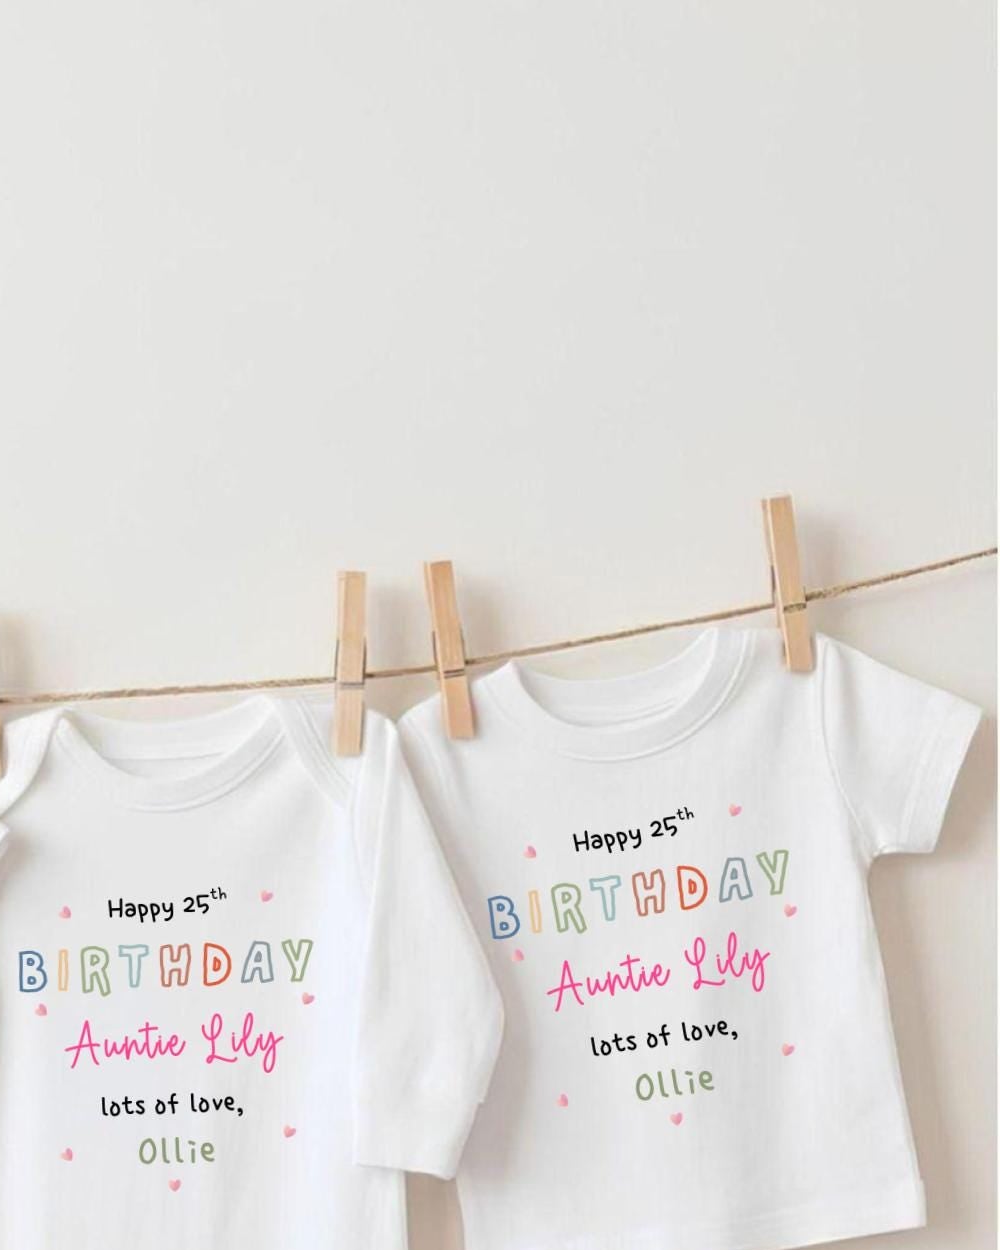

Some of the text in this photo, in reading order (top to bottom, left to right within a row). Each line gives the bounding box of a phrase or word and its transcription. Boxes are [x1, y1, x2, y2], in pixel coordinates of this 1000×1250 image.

[572, 807, 695, 854] Happy 25th
[108, 886, 227, 923] Happy 25th
[487, 849, 789, 940] BIRTHDAY
[18, 939, 313, 997] BIRTHDAY
[544, 931, 771, 1012] Auntie Lily
[64, 1012, 284, 1073] Auntie Lily
[590, 1020, 738, 1056] lots of love,
[101, 1093, 243, 1117] lots of love,
[635, 1069, 715, 1101] Ollie
[139, 1137, 215, 1165] Ollie
